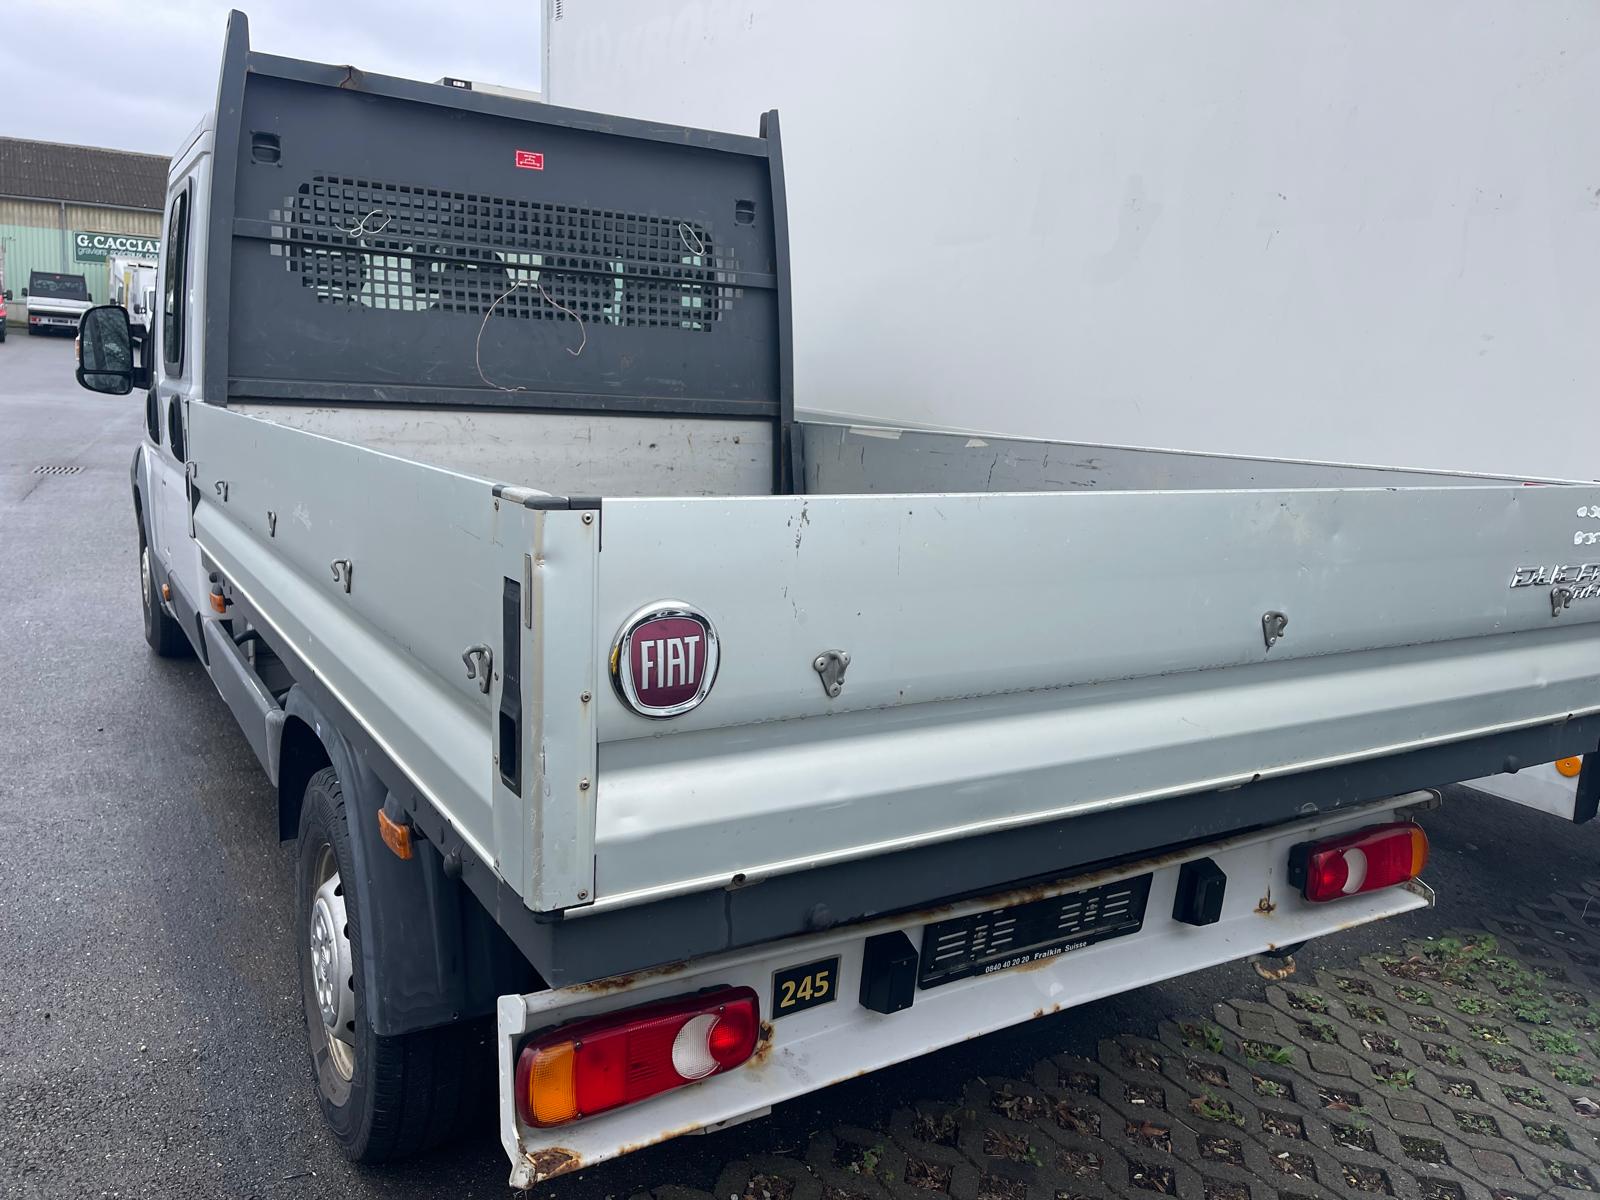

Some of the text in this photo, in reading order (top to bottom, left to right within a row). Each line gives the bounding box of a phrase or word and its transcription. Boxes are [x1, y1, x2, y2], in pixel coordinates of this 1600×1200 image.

[640, 635, 700, 690] FIAT
[985, 941, 1087, 974] 0840 40 20 20 Fraikin Suisse
[780, 970, 829, 1008] 245
